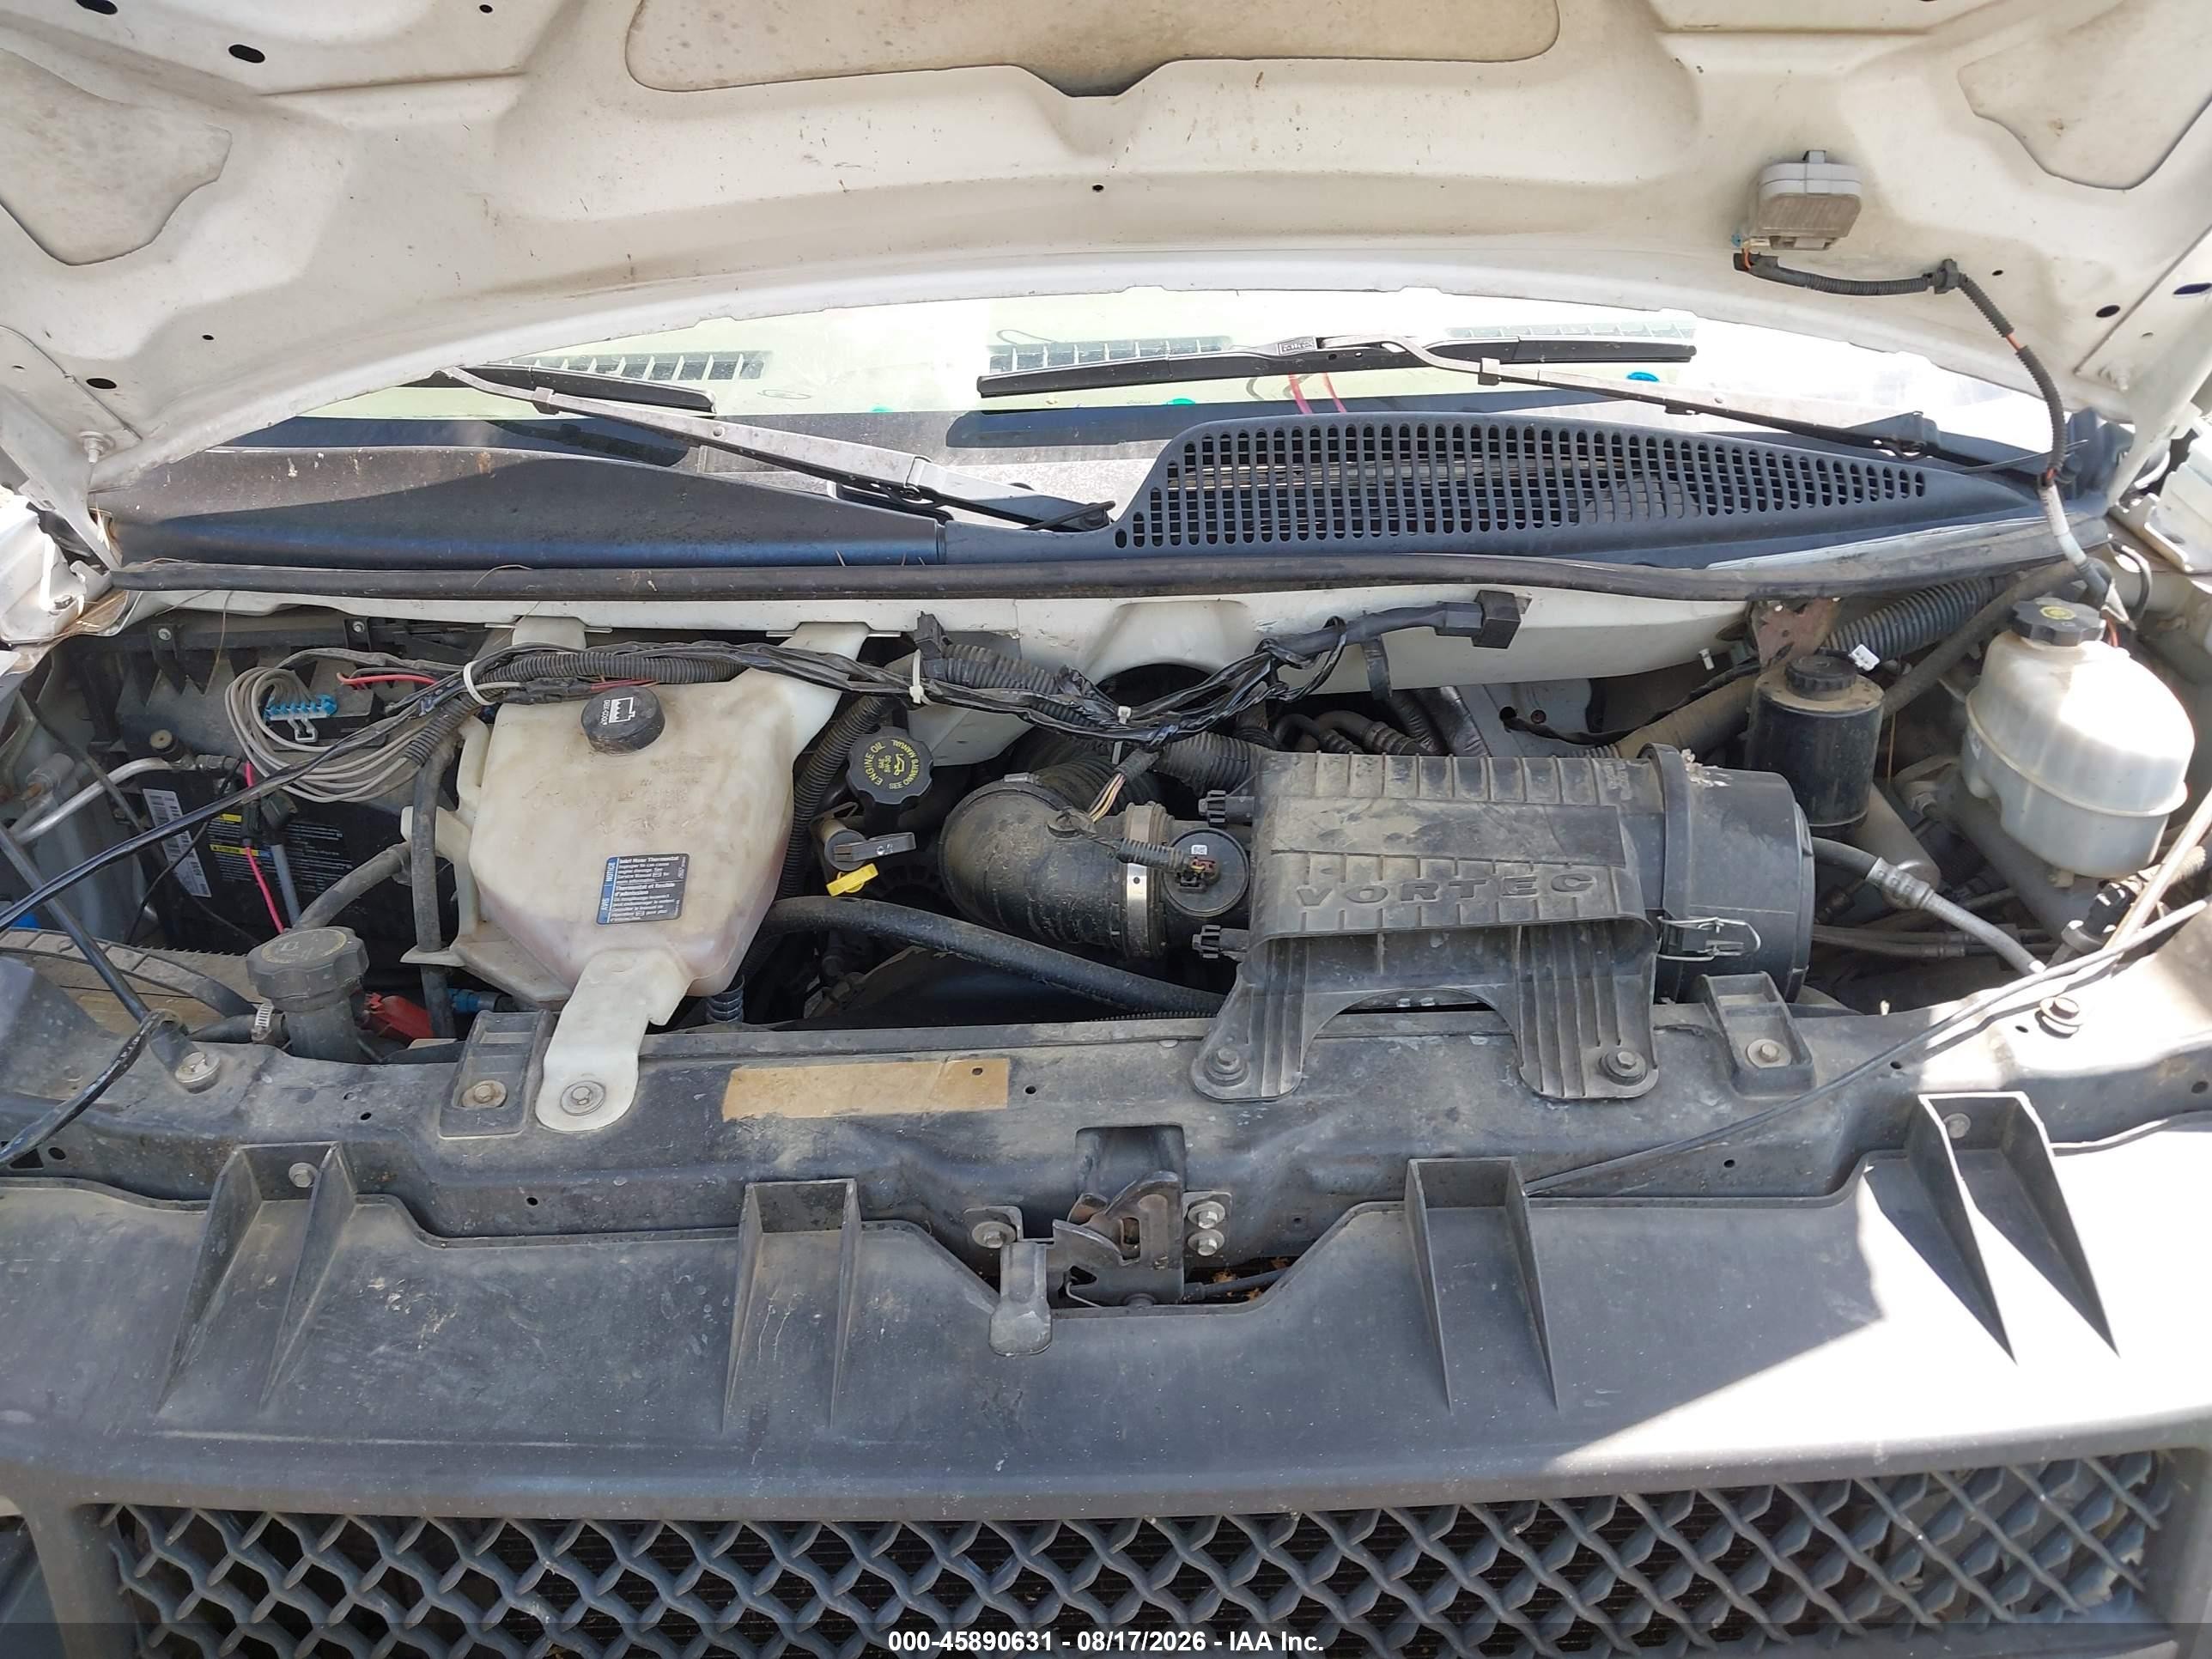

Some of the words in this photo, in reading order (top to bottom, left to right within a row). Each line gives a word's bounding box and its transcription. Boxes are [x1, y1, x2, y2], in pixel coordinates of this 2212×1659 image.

[871, 742, 886, 753] OIL
[890, 739, 917, 758] MANUAL
[864, 753, 884, 786] ENGINE
[605, 861, 616, 882] NOTICE
[1297, 873, 1594, 907] VORTEC
